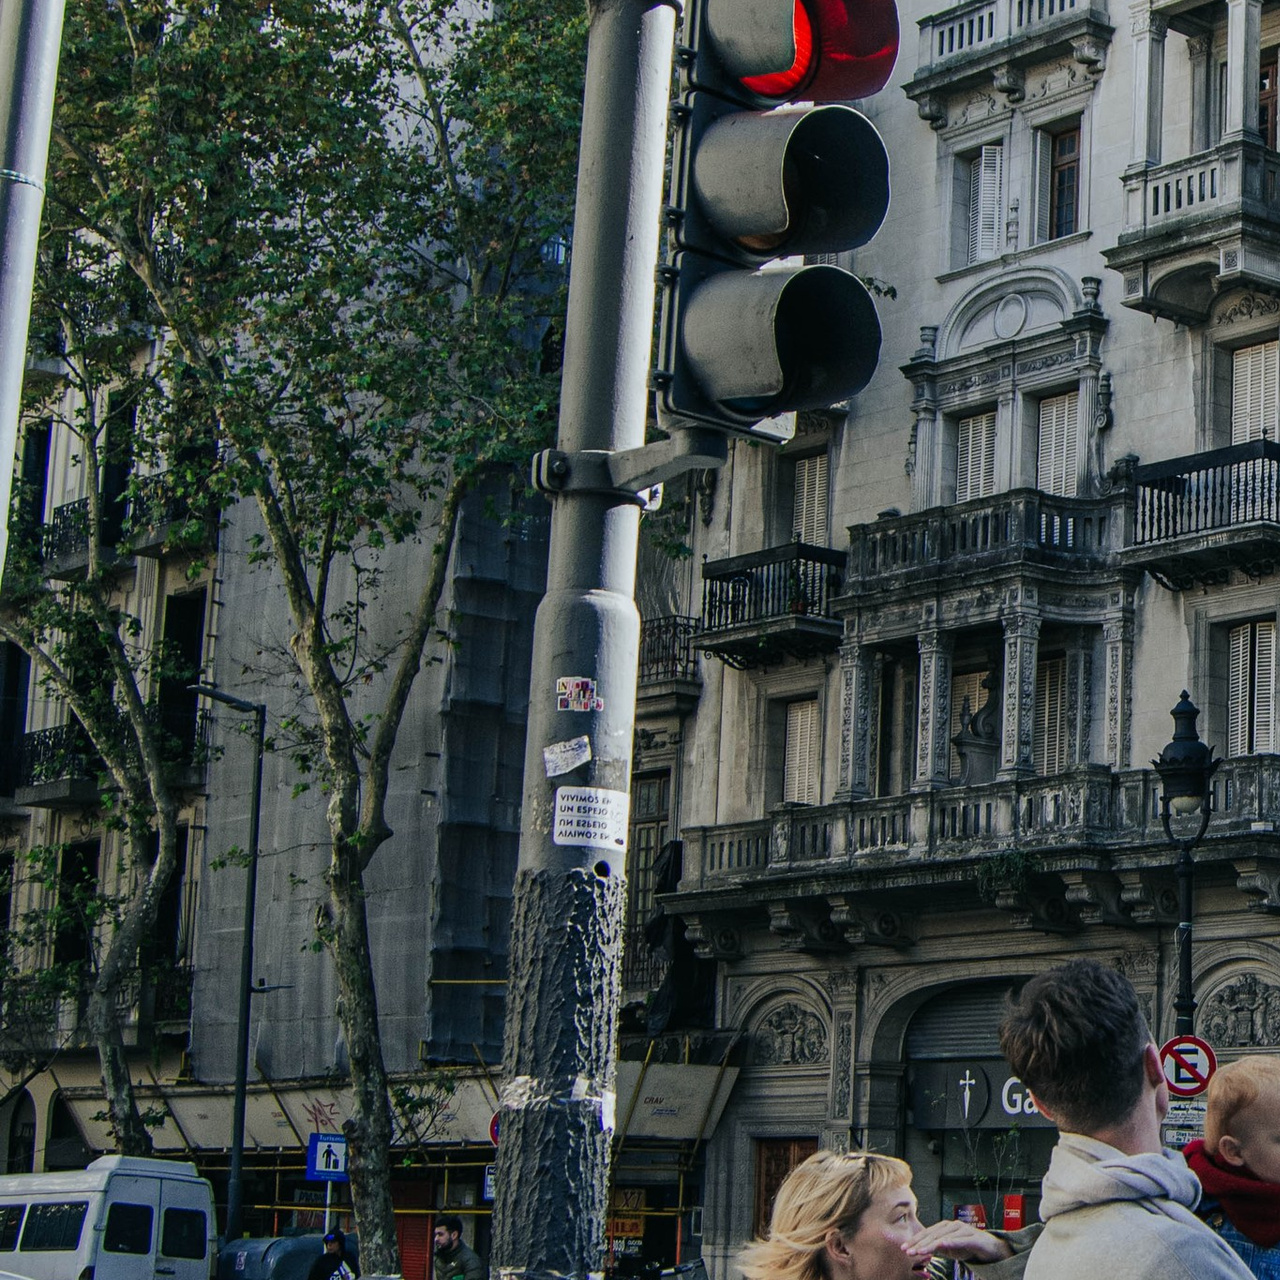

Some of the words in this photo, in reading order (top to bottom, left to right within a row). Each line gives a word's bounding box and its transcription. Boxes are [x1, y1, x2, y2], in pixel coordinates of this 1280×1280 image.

[560, 794, 599, 804] VIVIMOS
[560, 805, 574, 813] UN
[576, 805, 608, 816] ESPEJO
